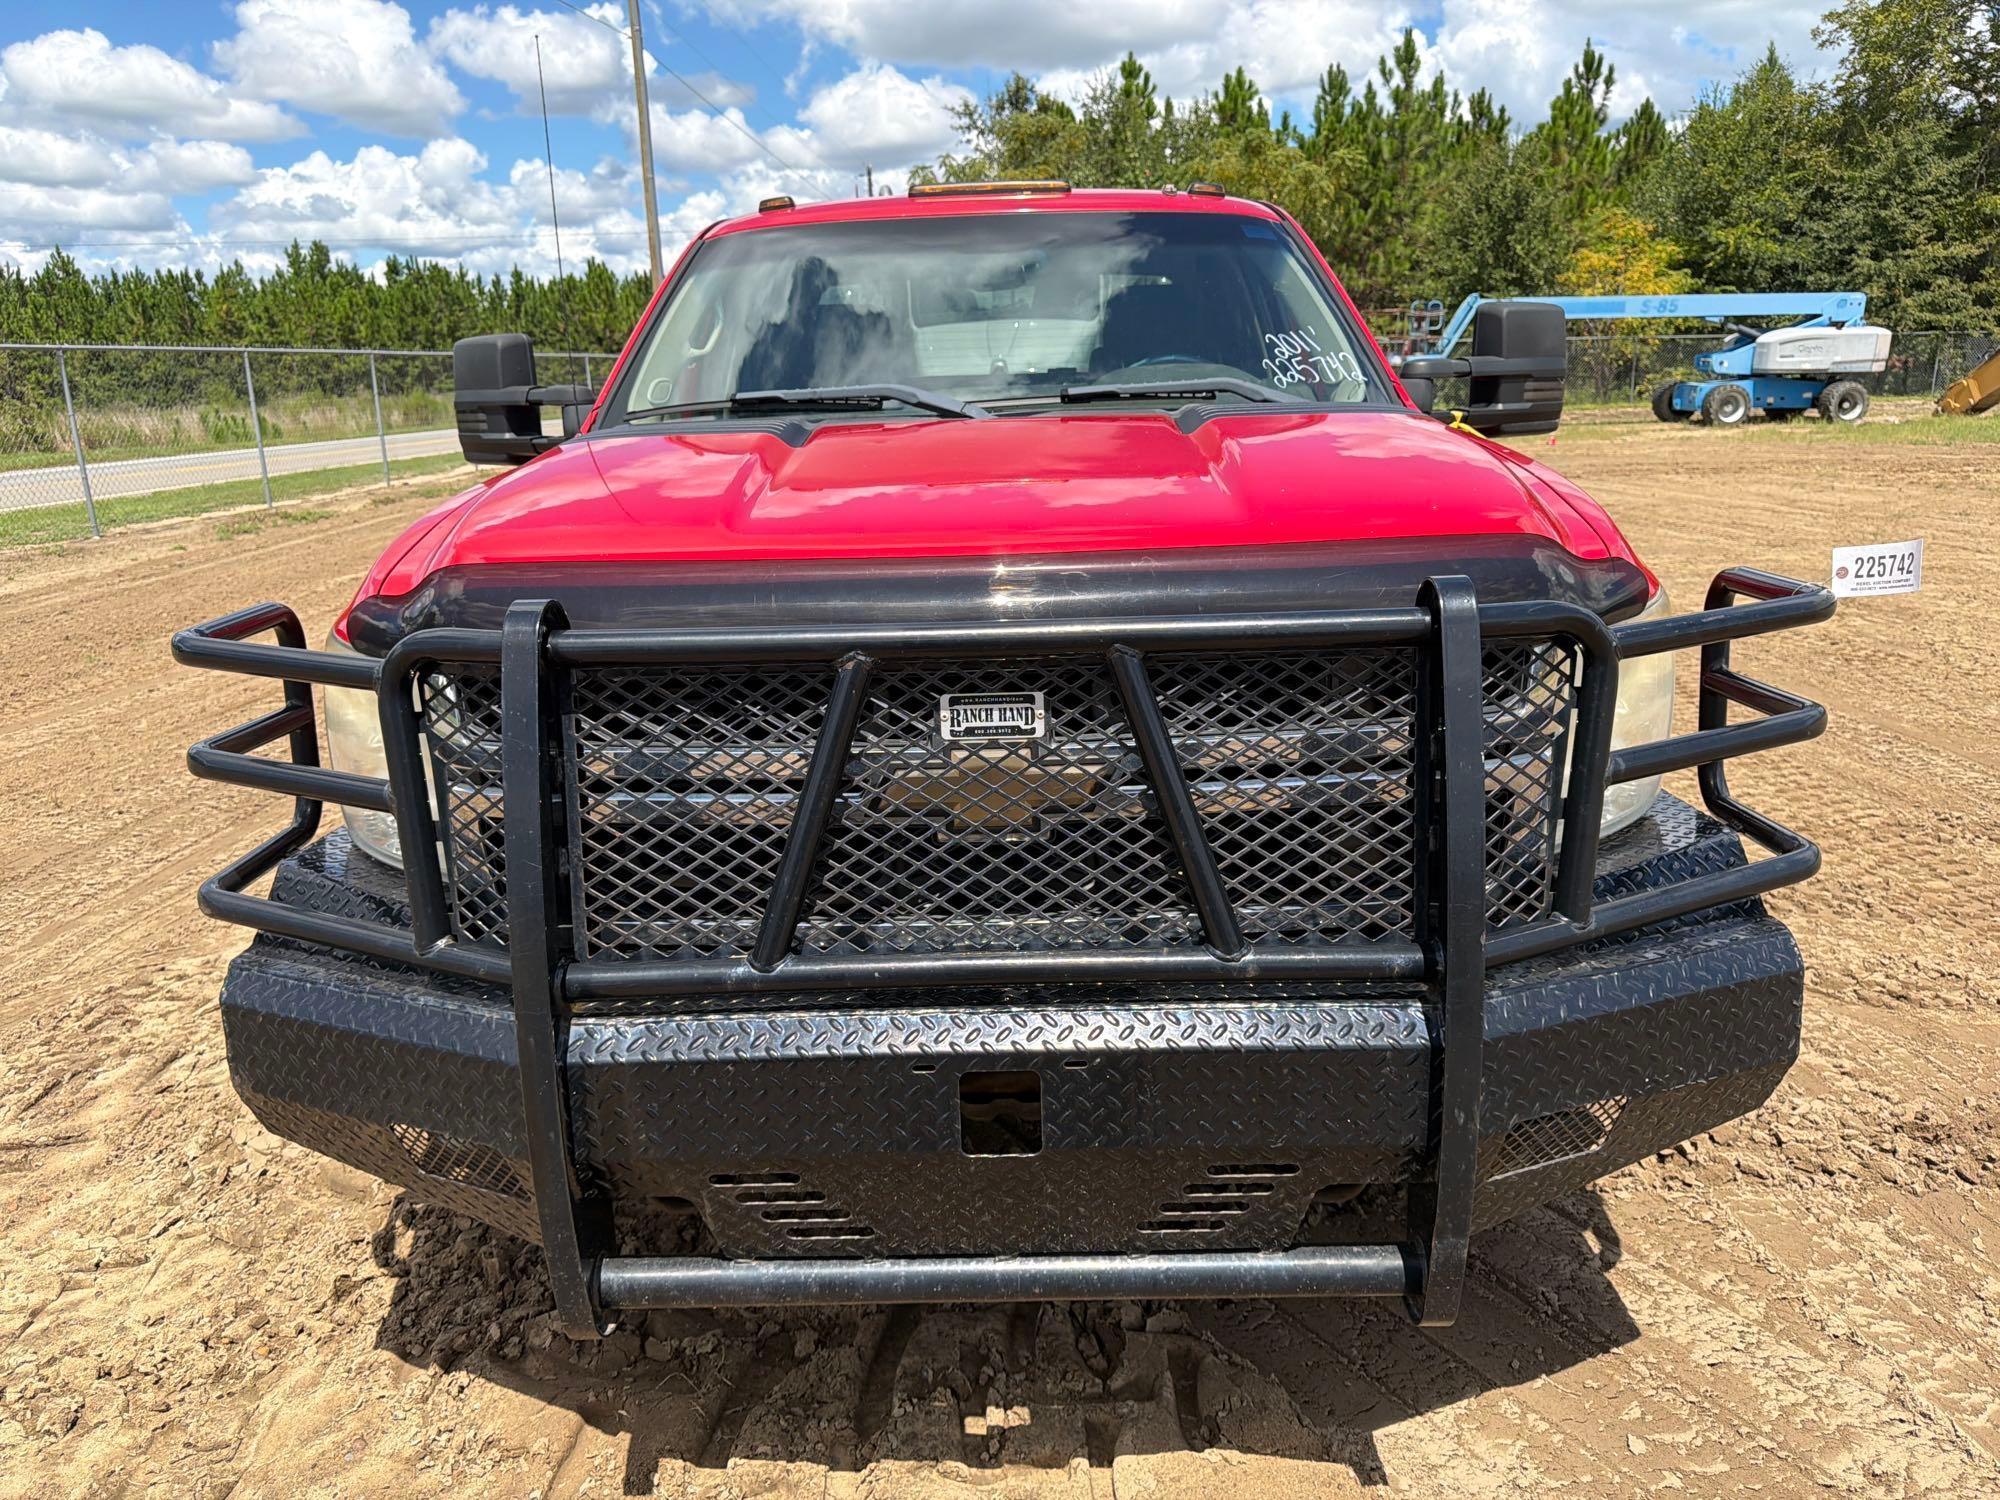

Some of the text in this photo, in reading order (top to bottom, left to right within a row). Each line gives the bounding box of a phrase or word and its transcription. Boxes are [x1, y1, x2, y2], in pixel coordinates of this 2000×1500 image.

[1640, 298, 1680, 314] S-85
[1262, 351, 1369, 389] 225742
[1854, 551, 1915, 579] 225742
[949, 706, 1036, 728] RANCH HAND
